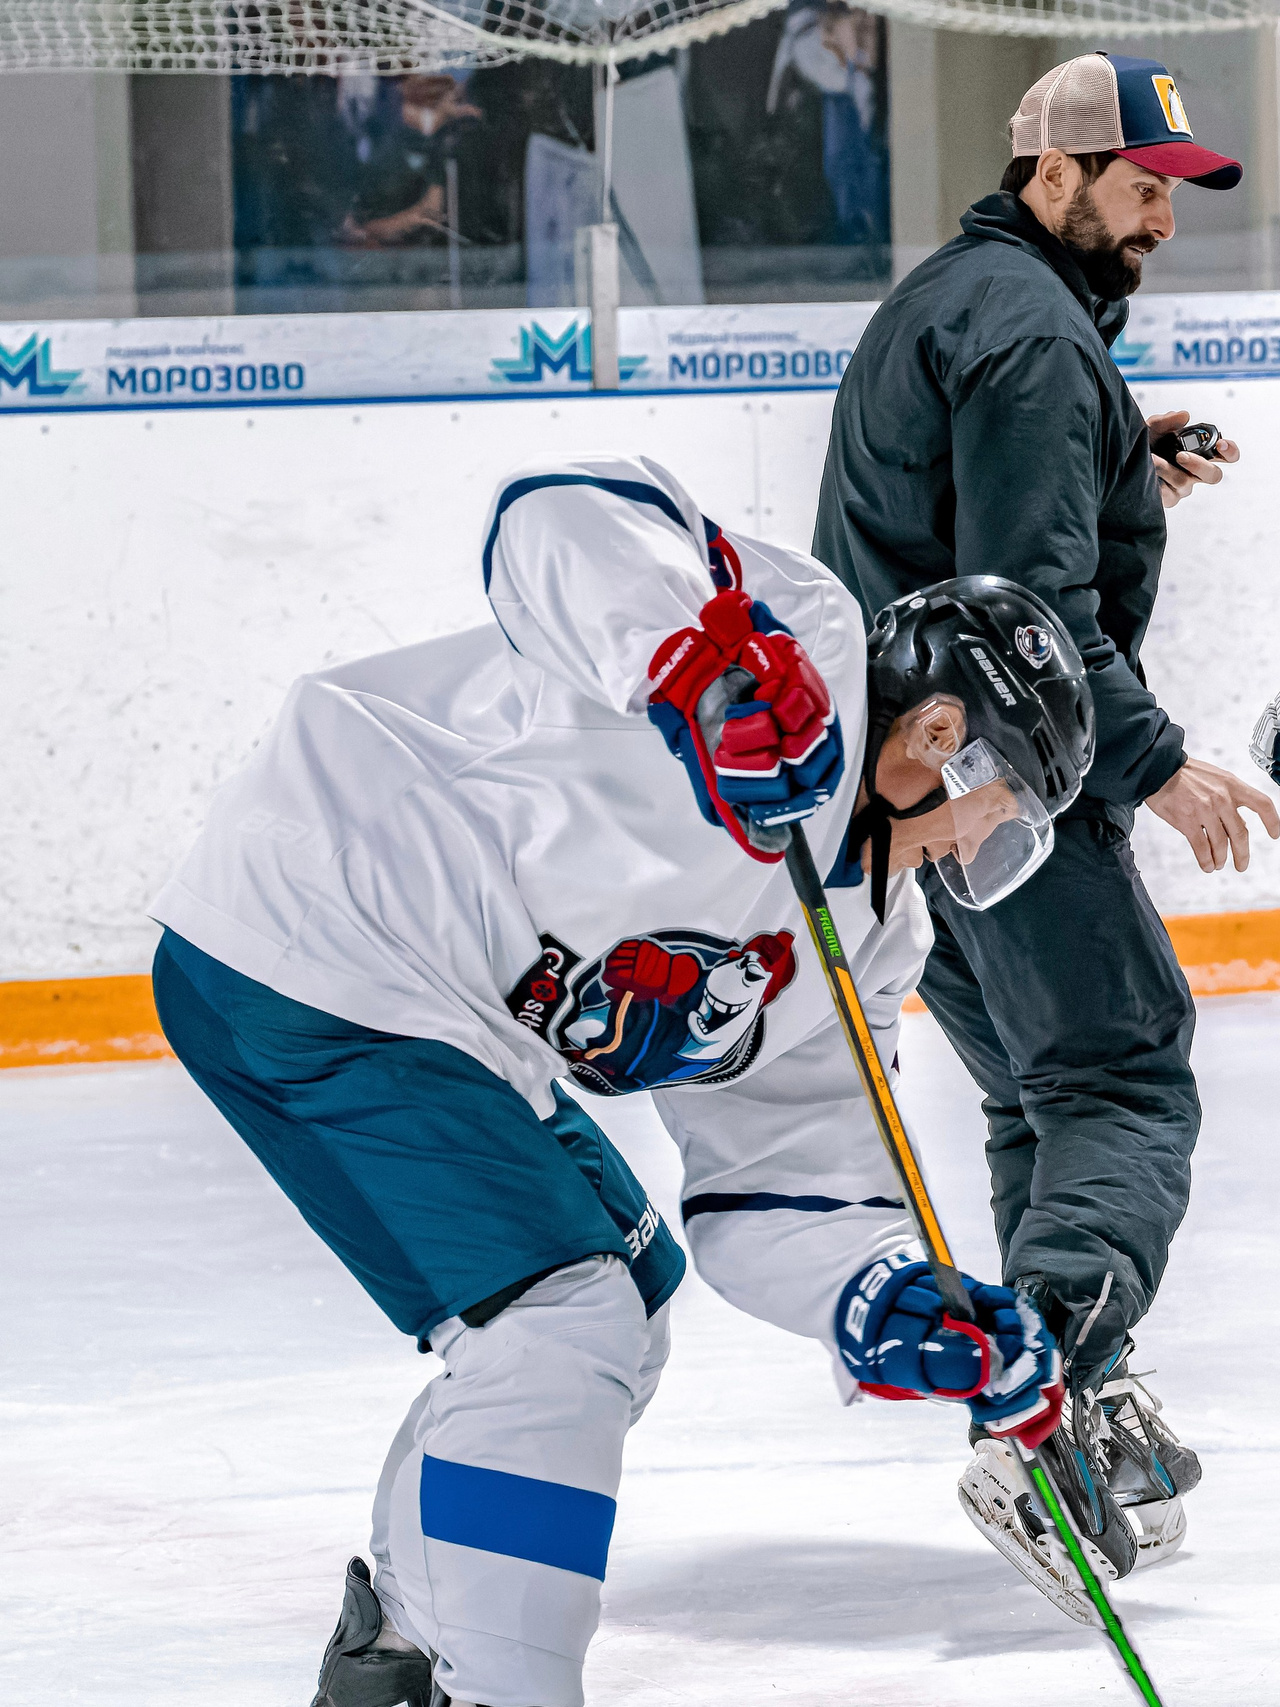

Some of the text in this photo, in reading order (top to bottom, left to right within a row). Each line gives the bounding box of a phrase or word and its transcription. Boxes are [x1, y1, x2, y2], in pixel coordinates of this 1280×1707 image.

[107, 363, 304, 395] МОРОЗОВО
[624, 1202, 660, 1260] BAU
[844, 1252, 918, 1343] BAU
[980, 1467, 1011, 1496] TRUE
